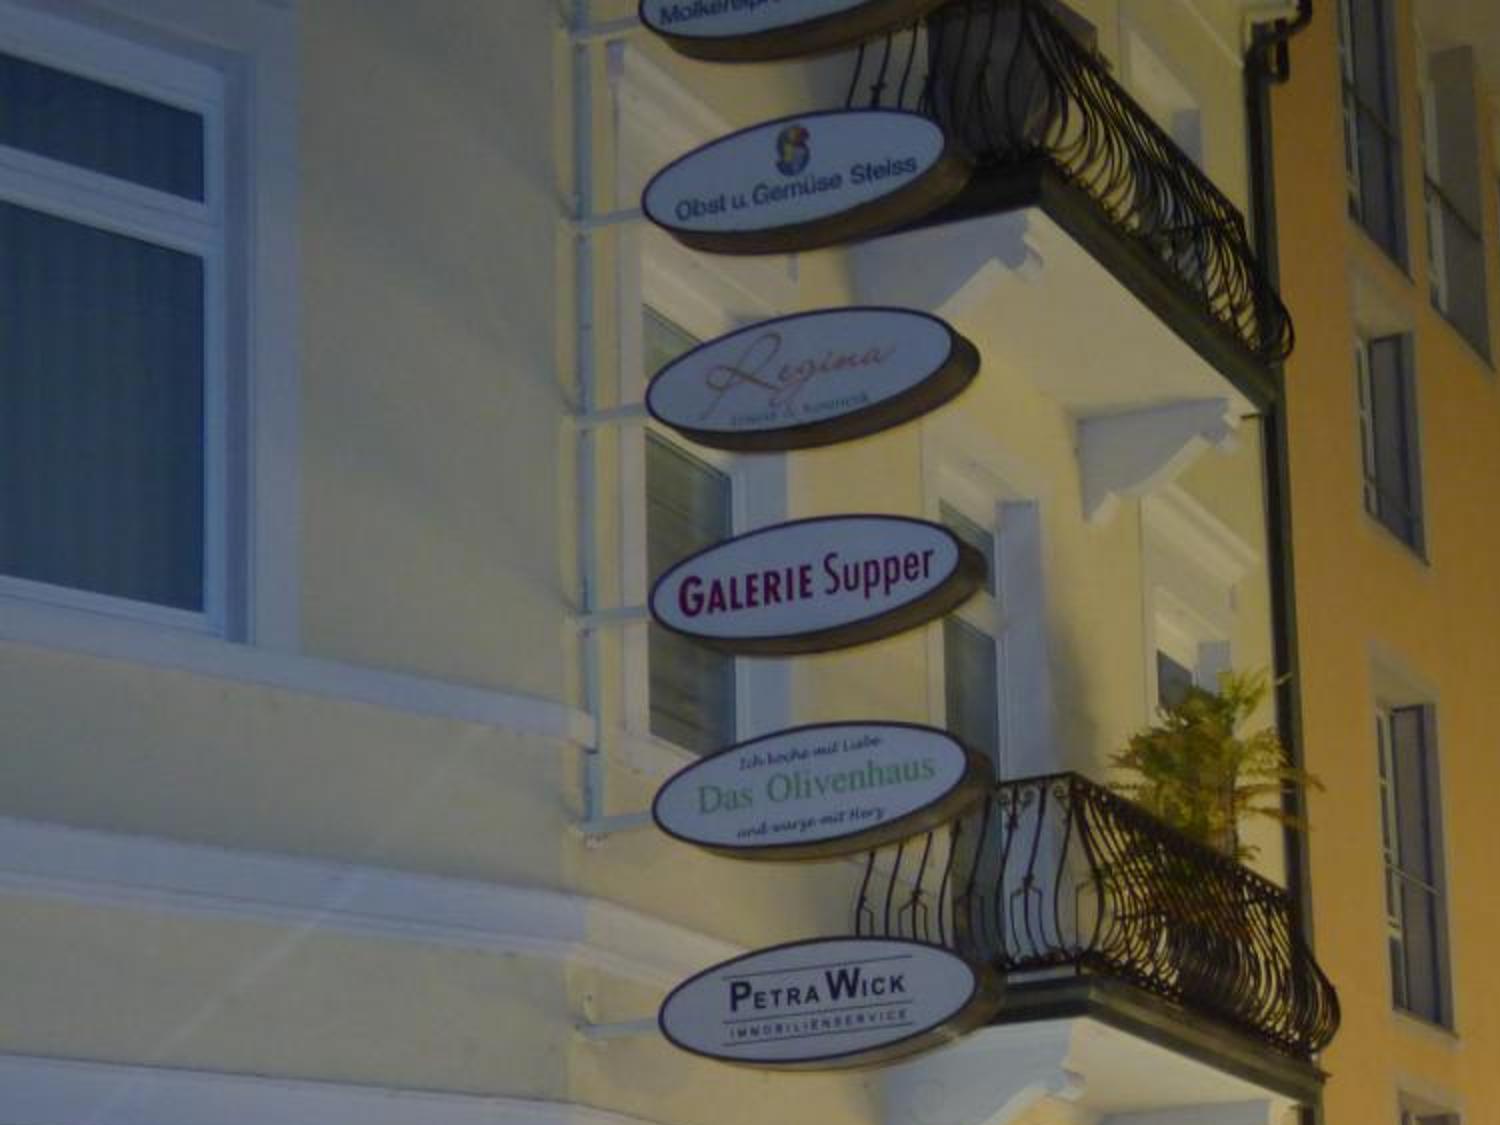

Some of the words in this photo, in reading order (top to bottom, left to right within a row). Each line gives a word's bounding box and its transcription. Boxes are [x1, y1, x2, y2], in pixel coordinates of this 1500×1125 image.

[675, 195, 727, 222] Obst
[752, 172, 843, 206] Gemüse
[850, 156, 917, 185] Steiss
[699, 332, 896, 421] Regina
[679, 565, 812, 618] GALERIE
[825, 547, 935, 599] Supper
[697, 785, 752, 815] Das
[766, 756, 936, 803] Olivenhaus
[730, 979, 820, 1012] PETRA
[825, 966, 907, 998] WICK
